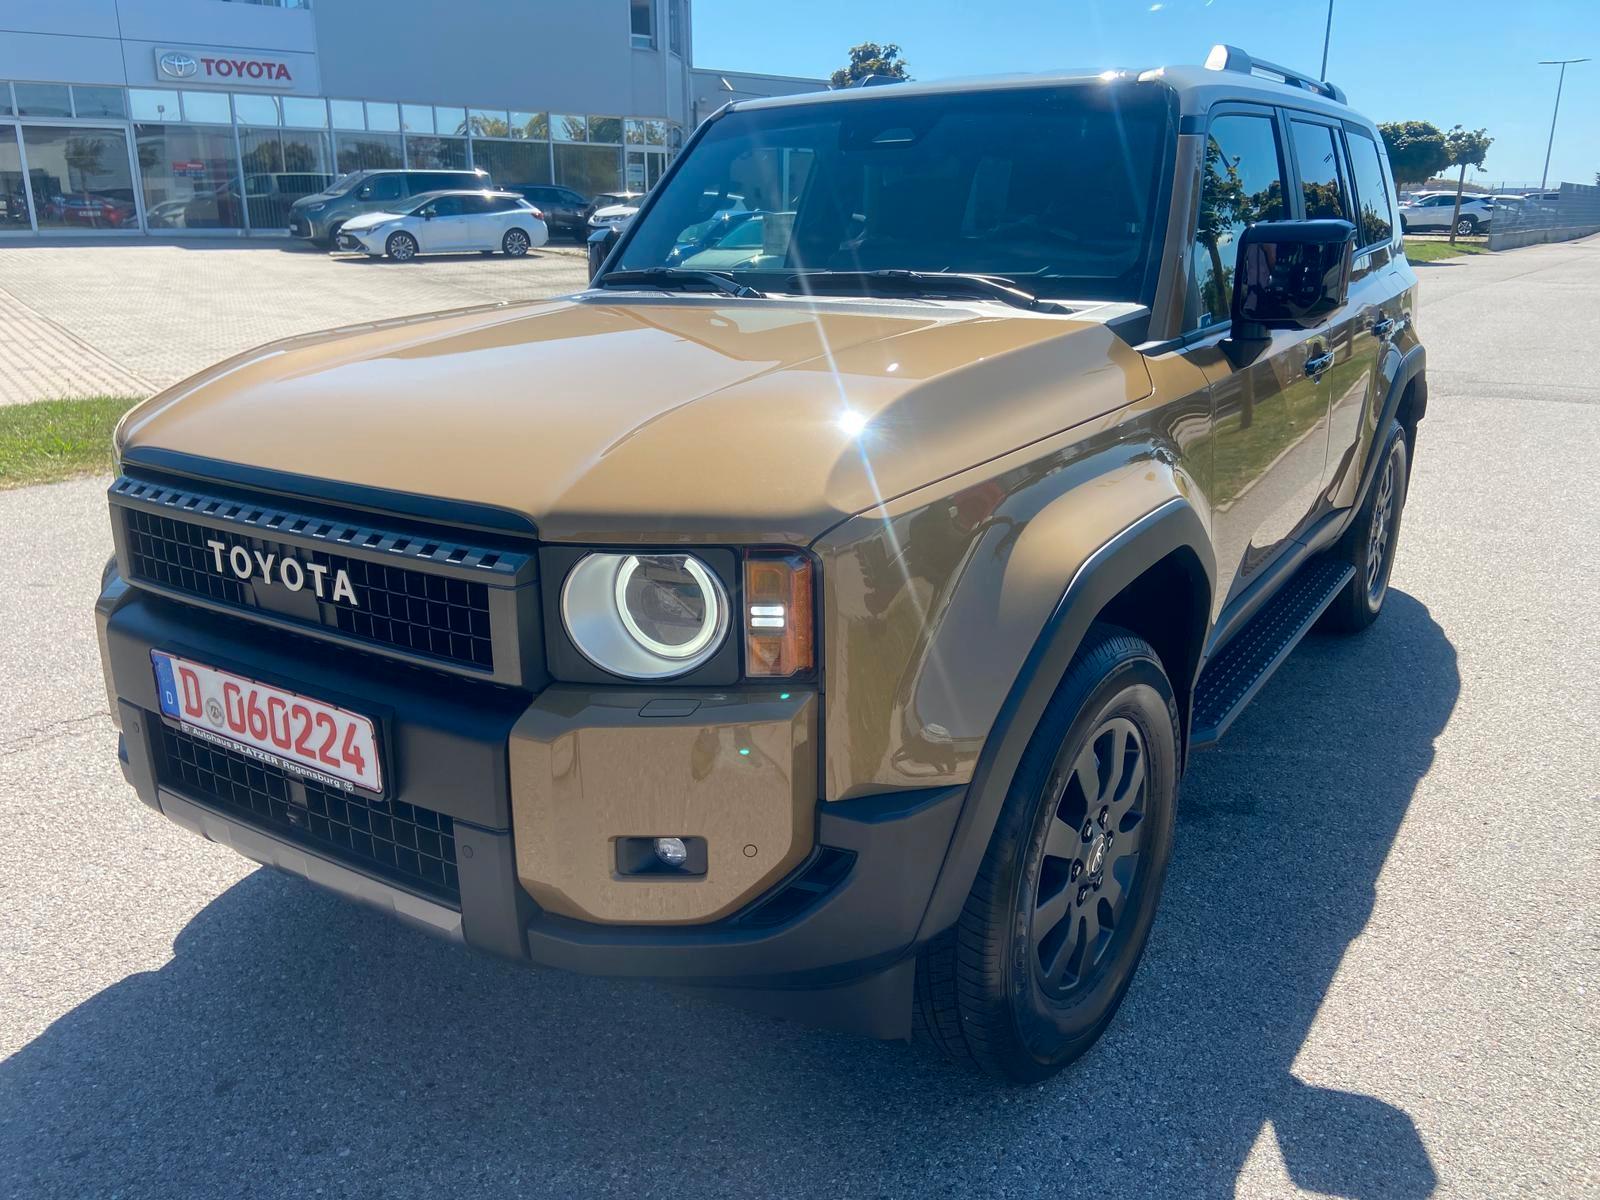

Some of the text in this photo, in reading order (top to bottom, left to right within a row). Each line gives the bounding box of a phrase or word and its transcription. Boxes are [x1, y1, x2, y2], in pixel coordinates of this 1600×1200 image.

[201, 58, 292, 80] TOYOTA
[207, 539, 358, 606] TOYOTA
[166, 690, 174, 705] D
[179, 667, 366, 776] D 060224
[193, 728, 341, 788] Autohaus PLATZER Regensburg
